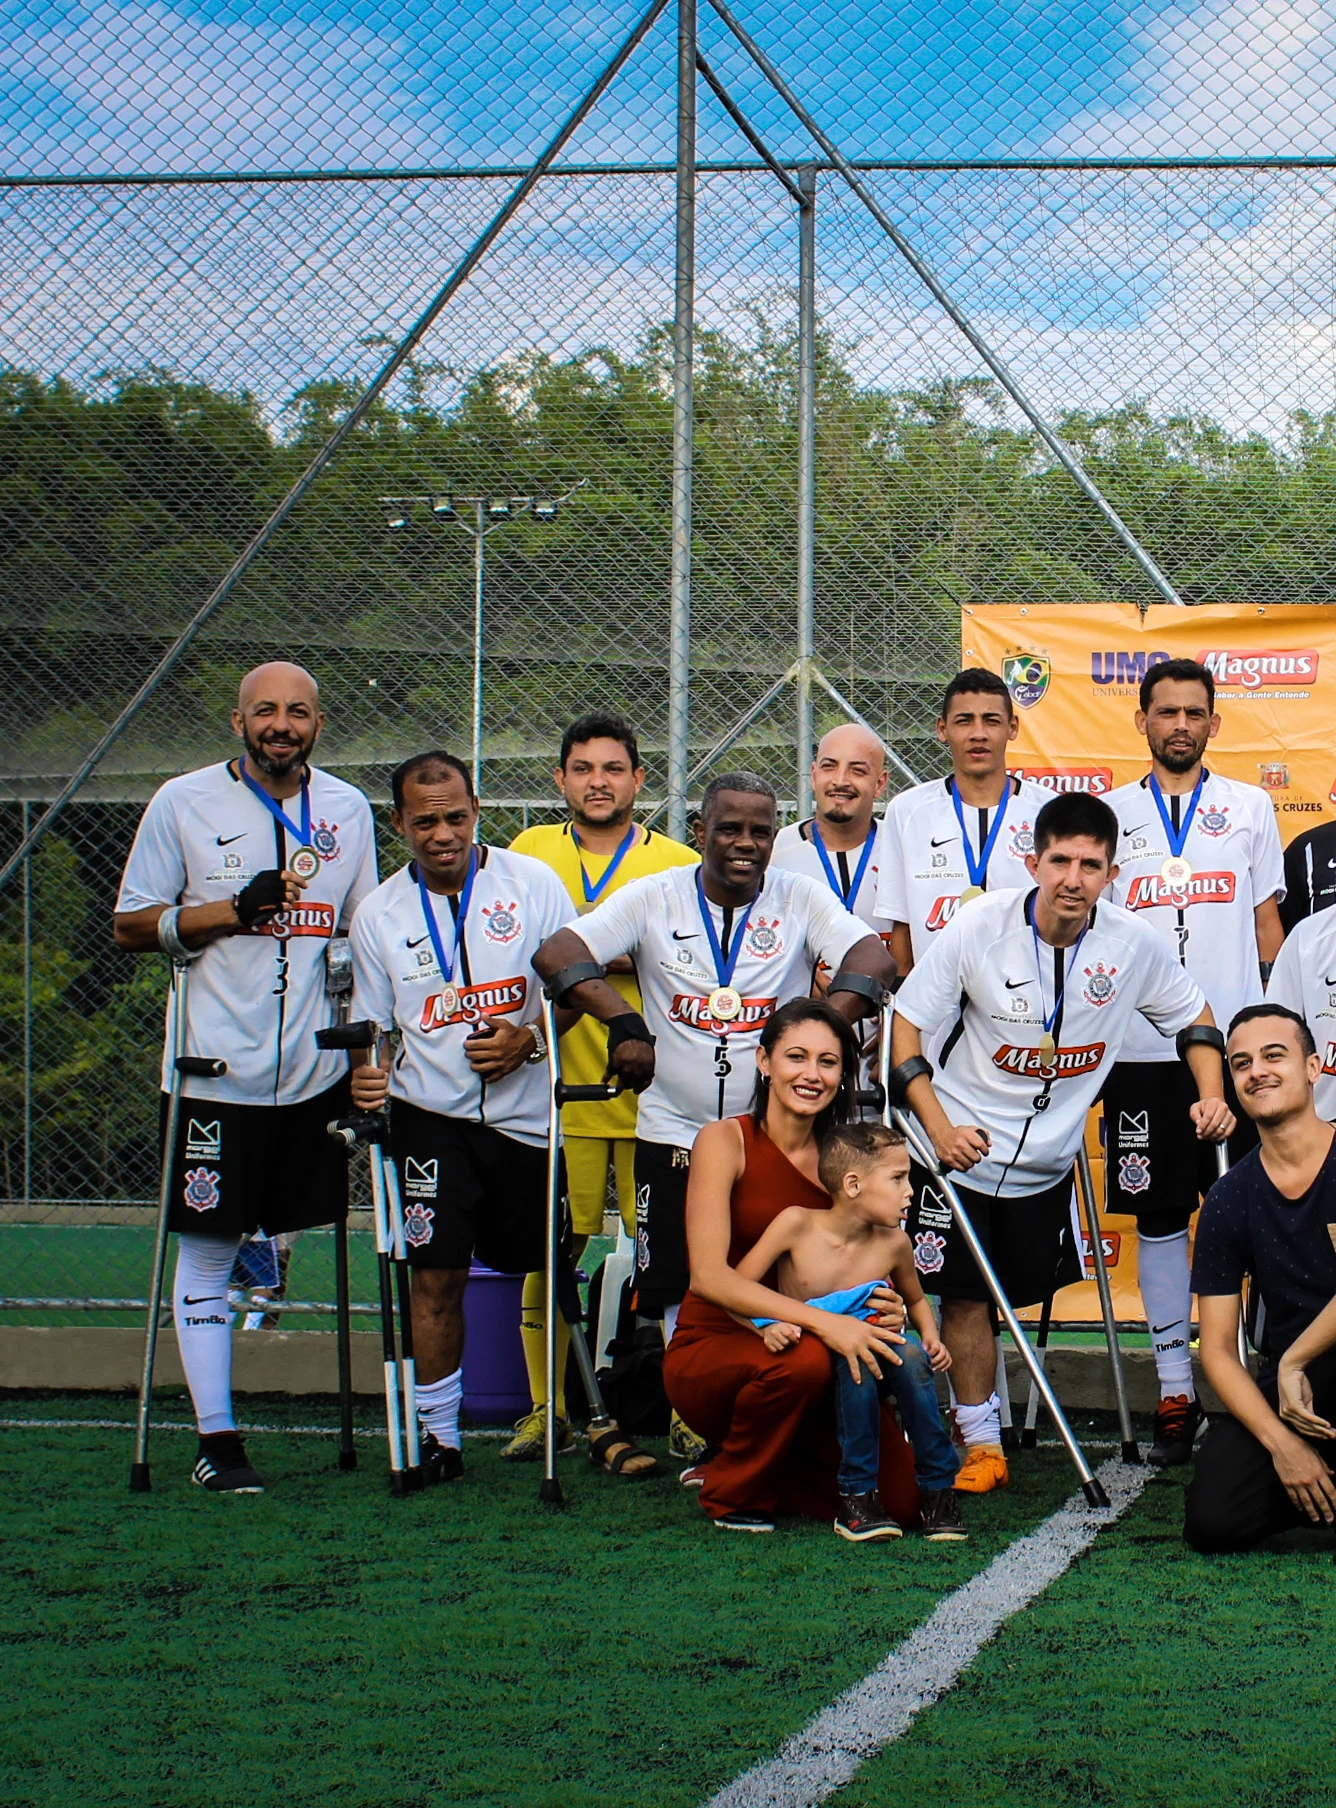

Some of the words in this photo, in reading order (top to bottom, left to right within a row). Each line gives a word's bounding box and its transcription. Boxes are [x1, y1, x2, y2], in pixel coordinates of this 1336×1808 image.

[1091, 651, 1170, 685] UM
[1092, 687, 1141, 697] UNIVERS
[1246, 691, 1273, 699] Gente
[1274, 691, 1310, 699] Entende
[1282, 803, 1323, 812] CRUZES
[272, 956, 290, 996] 3
[714, 1048, 731, 1078] 5
[184, 1315, 226, 1327] Timão
[1156, 1338, 1185, 1353] Timão
